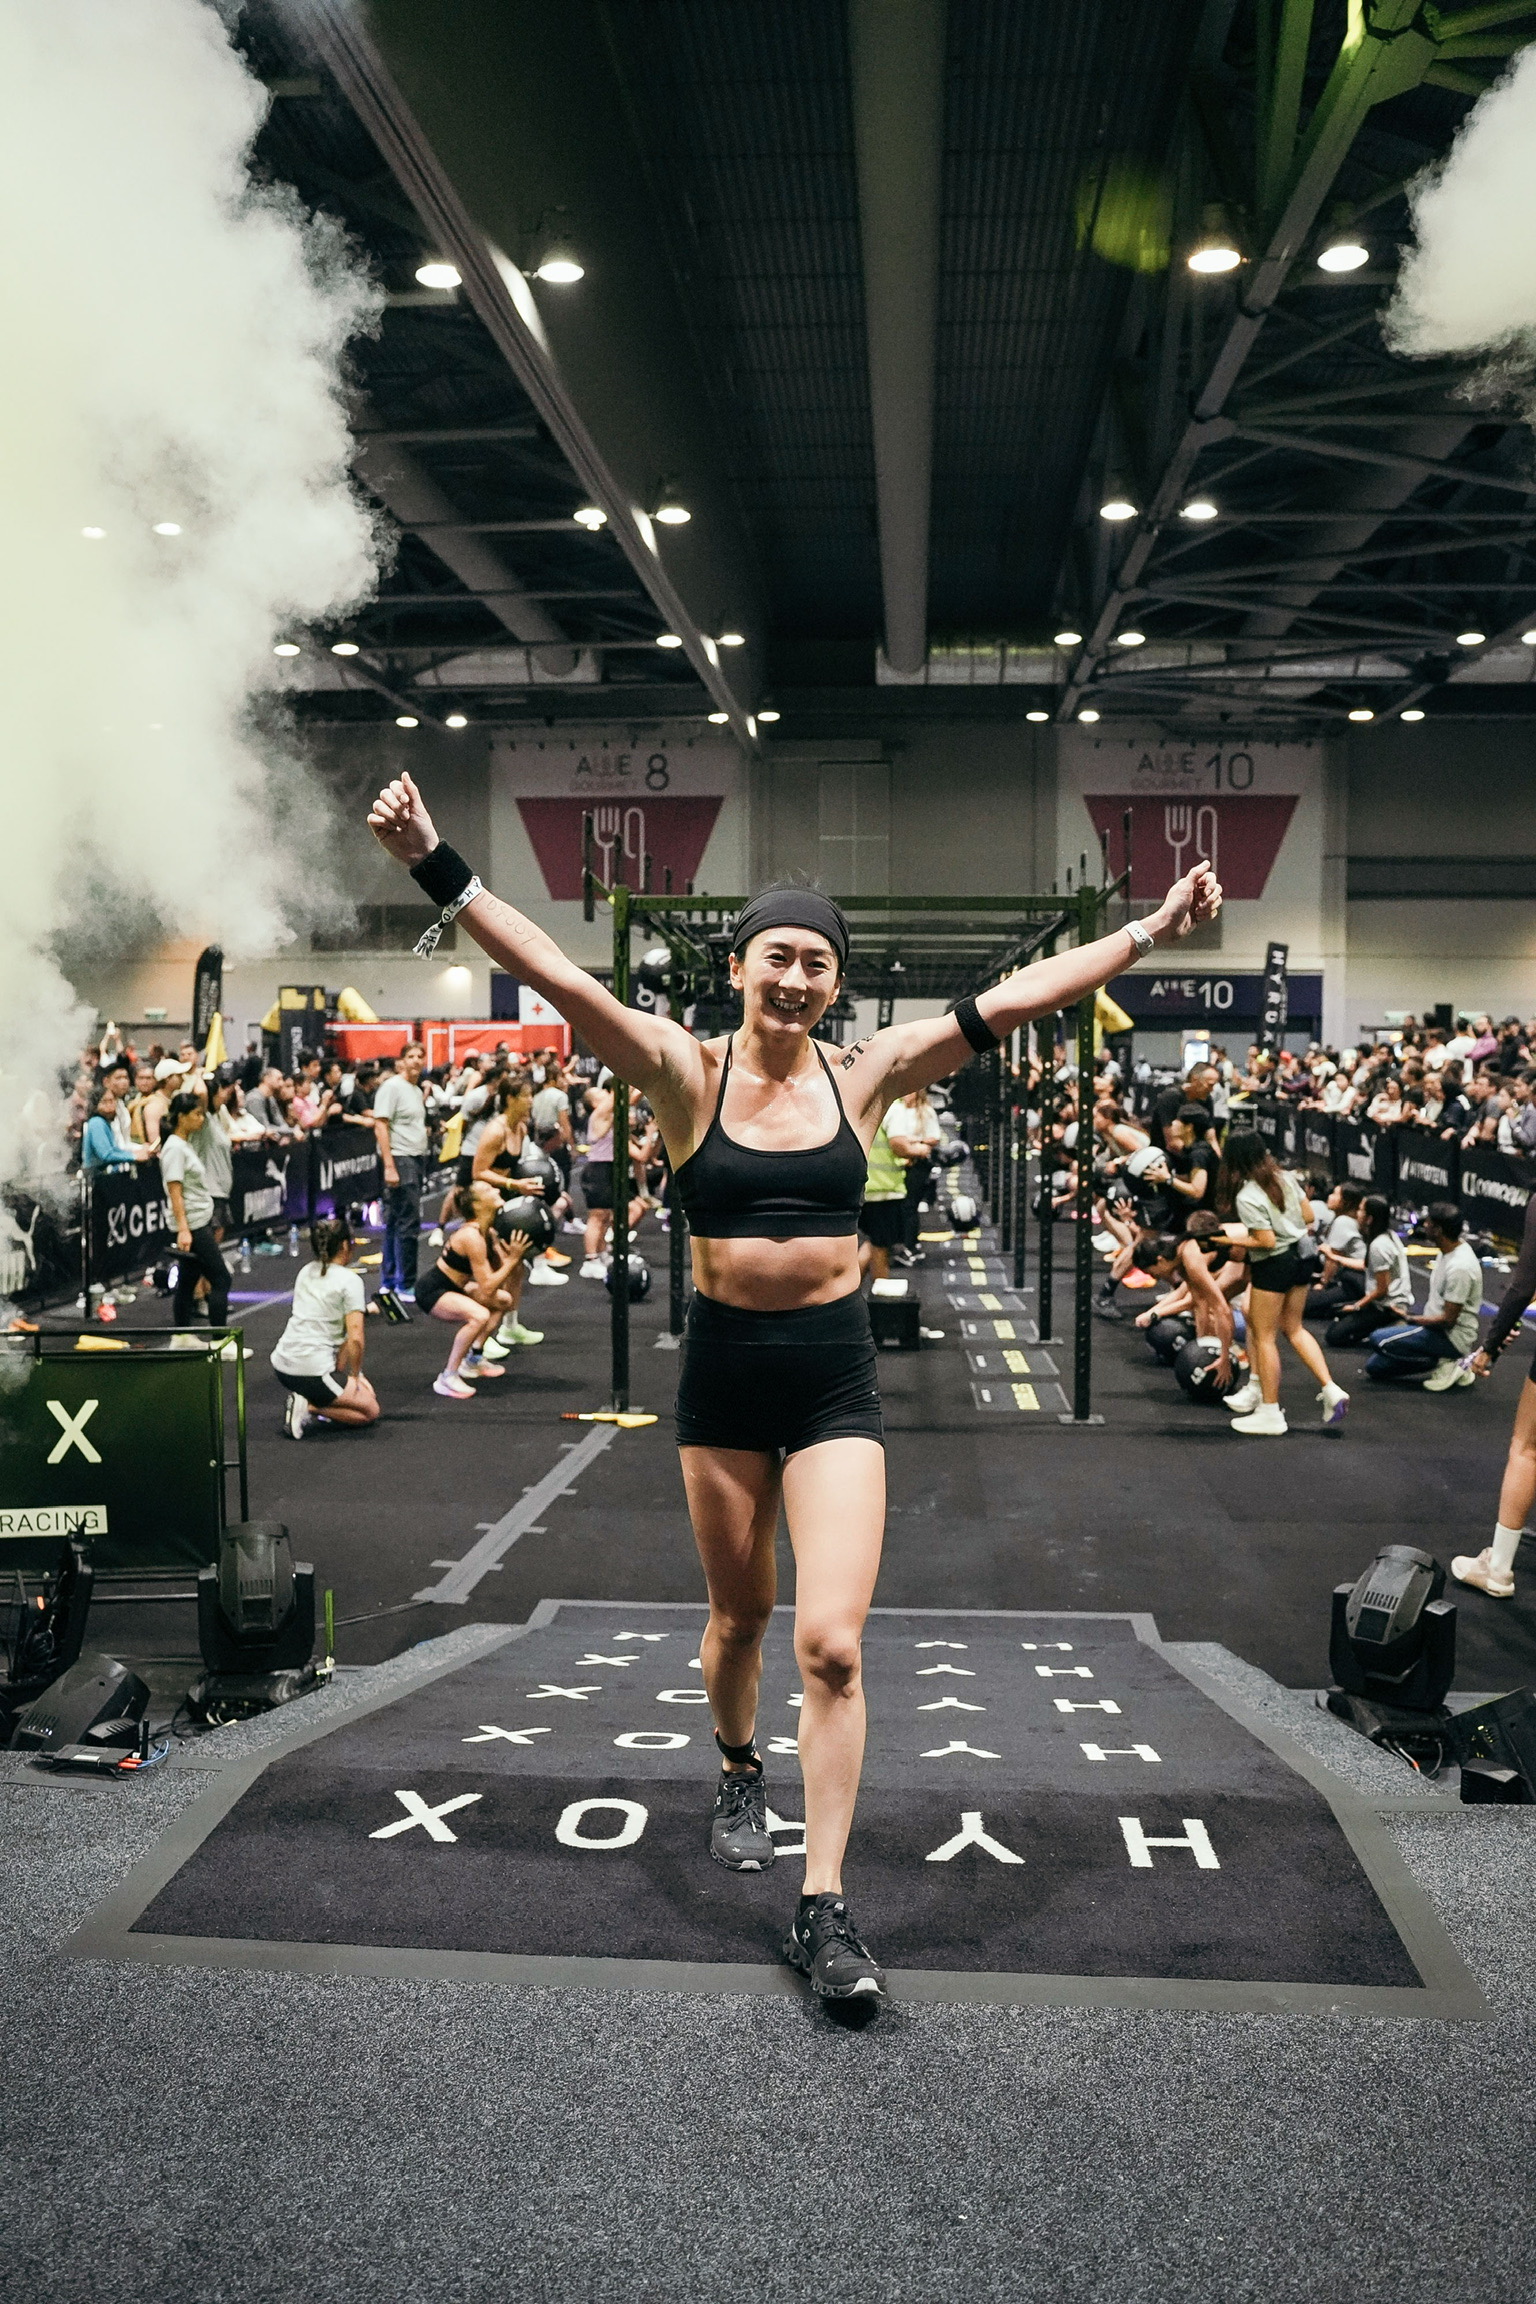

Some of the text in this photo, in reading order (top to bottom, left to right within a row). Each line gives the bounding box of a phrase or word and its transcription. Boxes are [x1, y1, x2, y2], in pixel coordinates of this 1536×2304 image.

[645, 753, 670, 791] 8
[1205, 752, 1255, 790] 10
[1198, 980, 1233, 1009] 10
[0, 1510, 99, 1533] RACING
